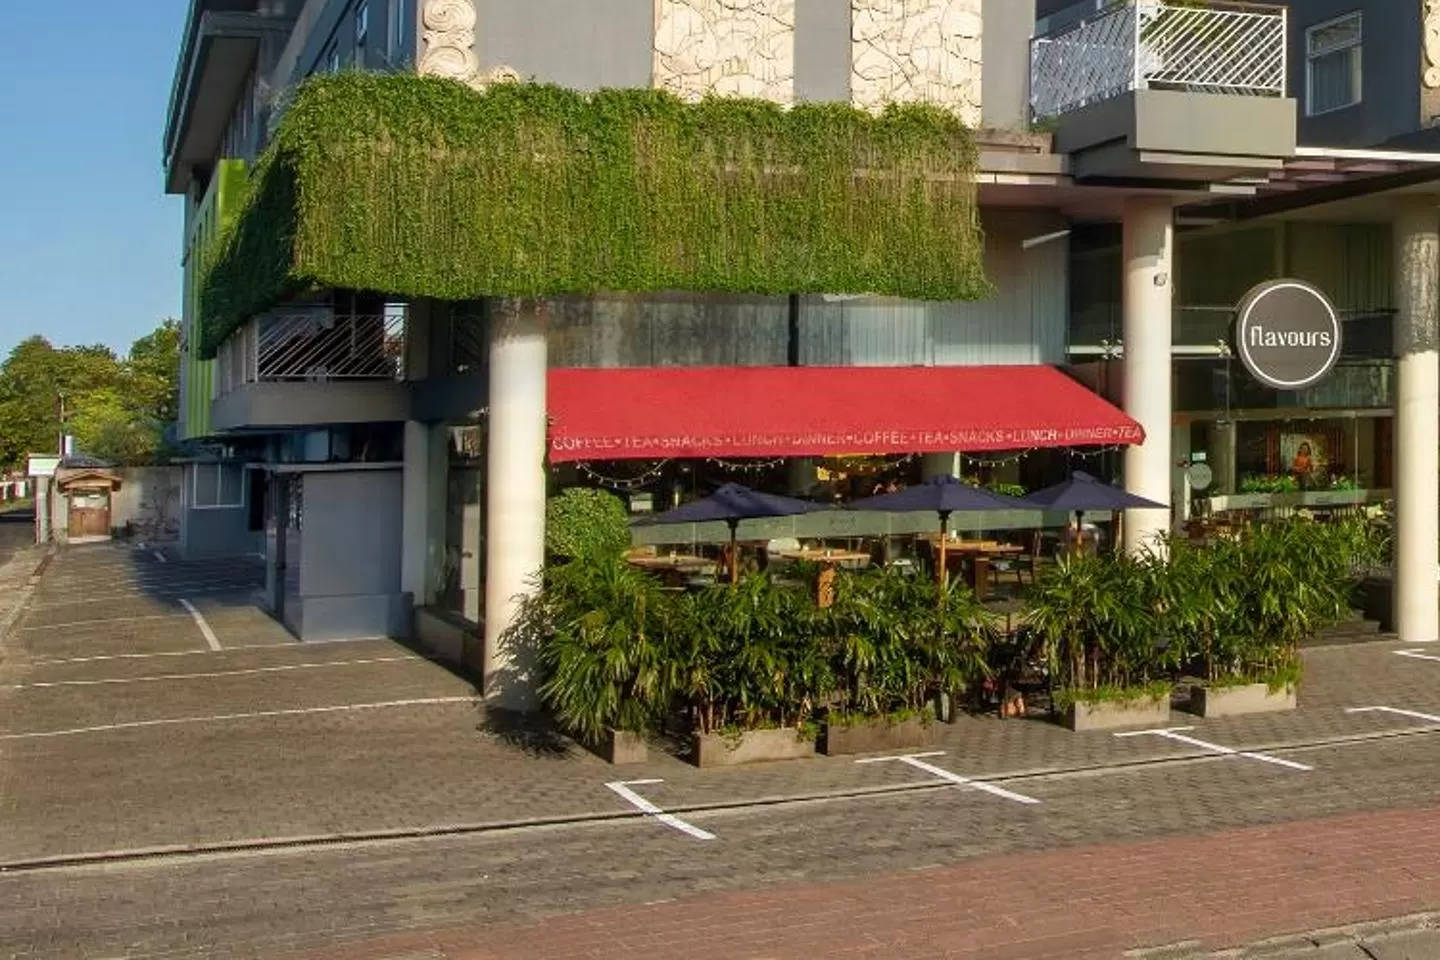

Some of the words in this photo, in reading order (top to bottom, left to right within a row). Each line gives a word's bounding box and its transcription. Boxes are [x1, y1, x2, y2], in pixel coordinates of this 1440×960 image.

[1250, 325, 1332, 347] flavours
[853, 431, 909, 445] COFFEE
[918, 430, 944, 444] TEA
[949, 429, 1005, 444] SNACKS
[1012, 427, 1058, 442] LUNCH
[1117, 425, 1142, 439] TEA
